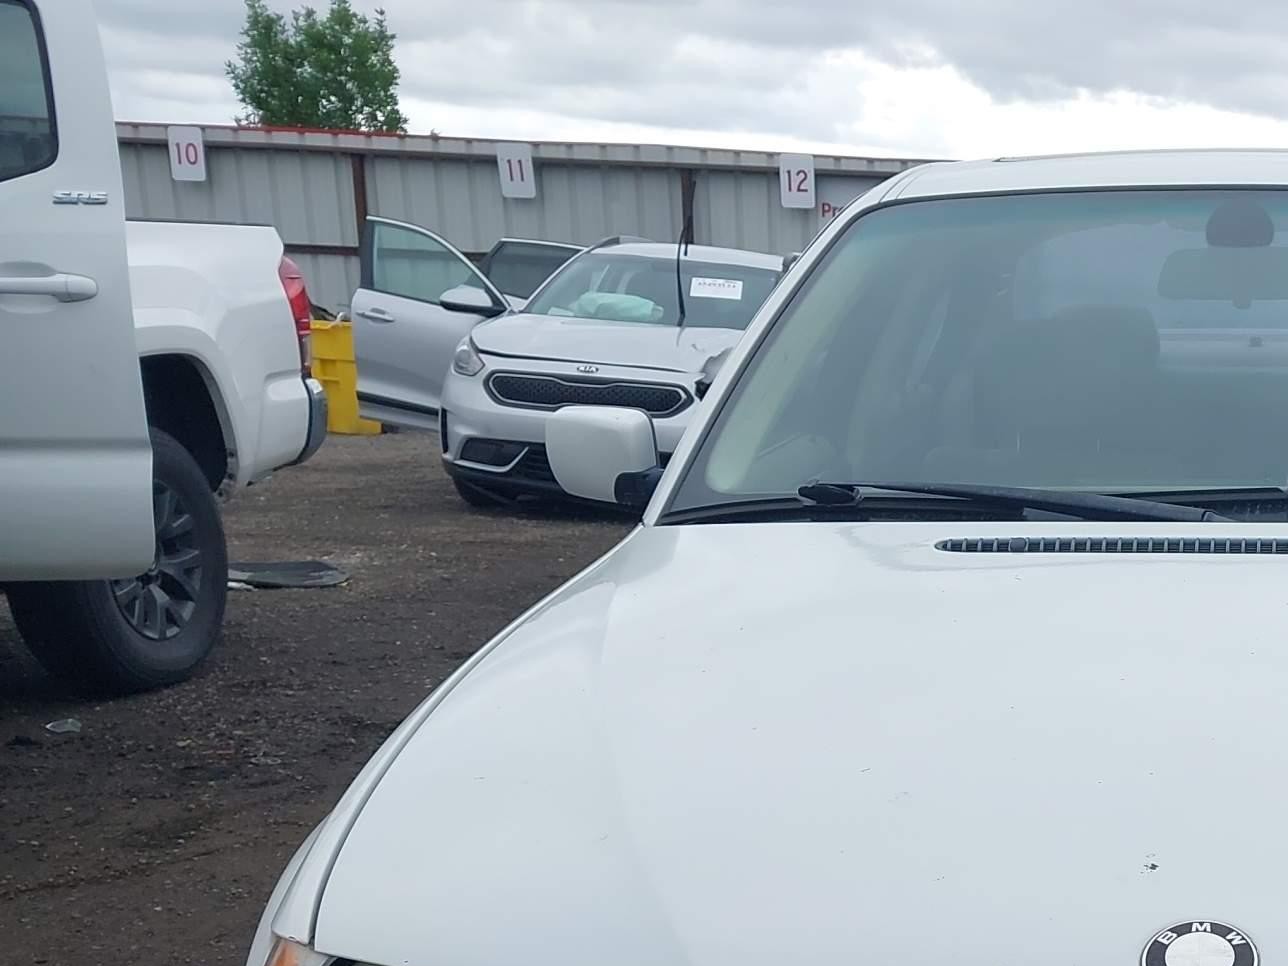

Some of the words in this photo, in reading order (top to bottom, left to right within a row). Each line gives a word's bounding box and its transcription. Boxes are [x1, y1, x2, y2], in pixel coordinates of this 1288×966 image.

[175, 142, 199, 165] 10
[507, 159, 526, 182] 11
[786, 169, 808, 192] 12
[1156, 921, 1248, 946] BMW
